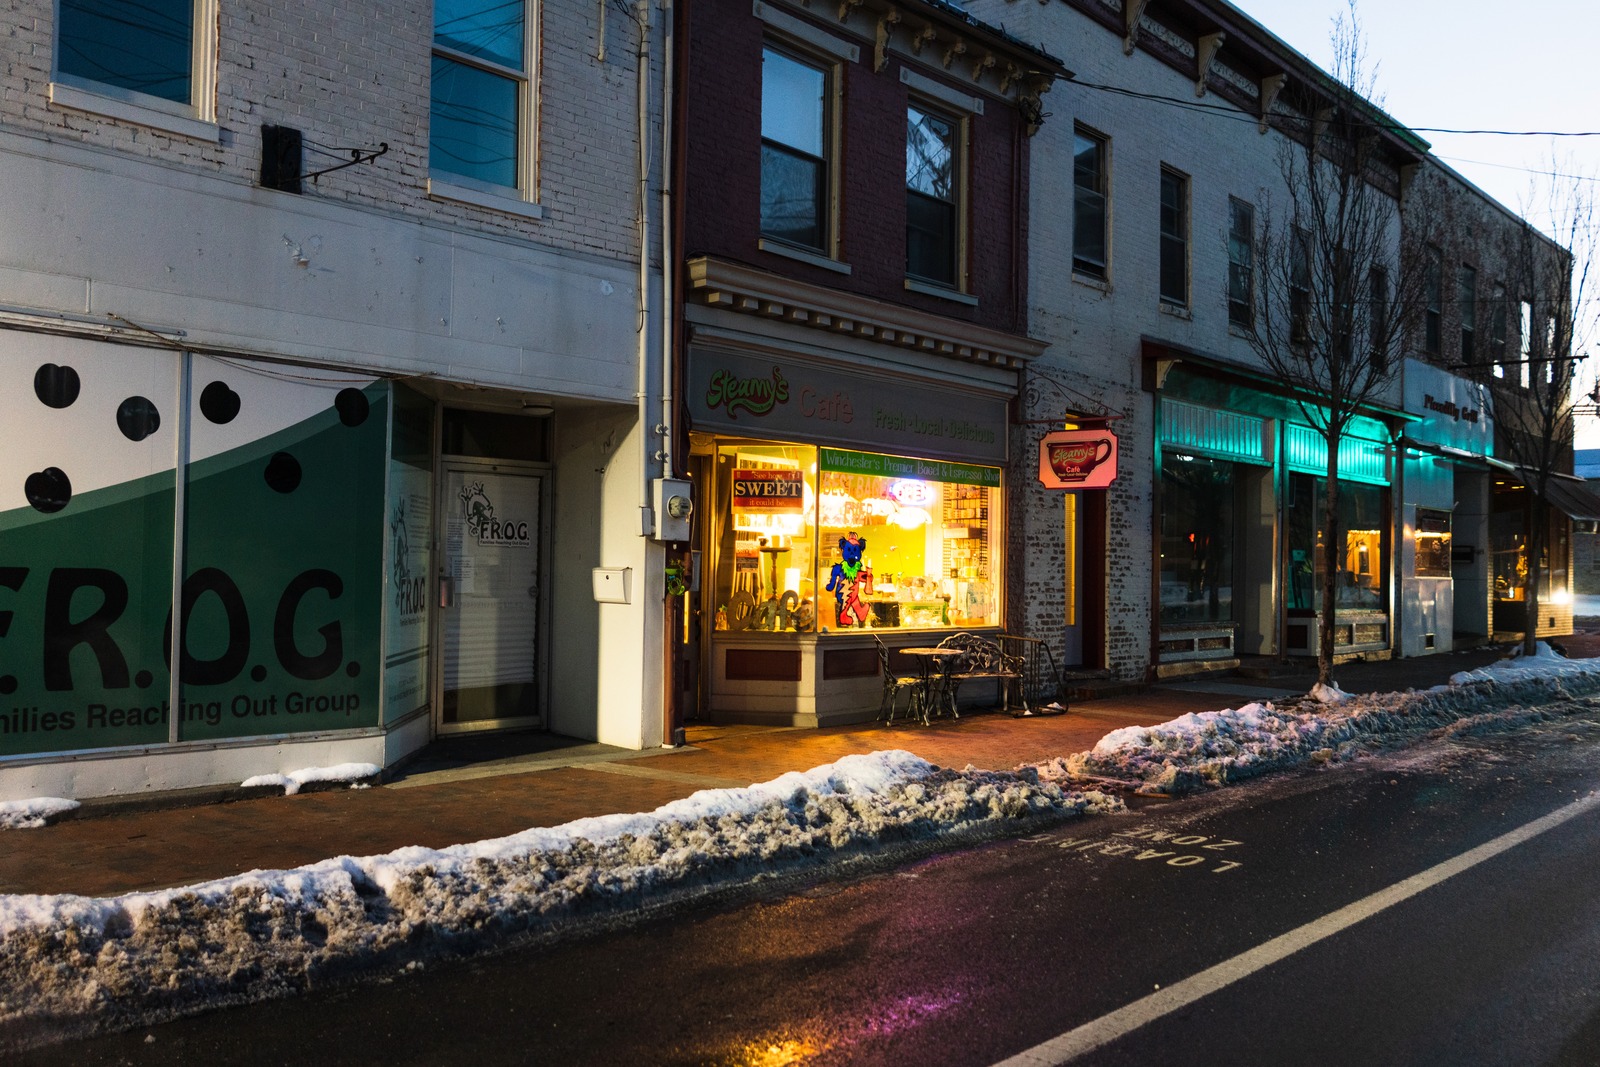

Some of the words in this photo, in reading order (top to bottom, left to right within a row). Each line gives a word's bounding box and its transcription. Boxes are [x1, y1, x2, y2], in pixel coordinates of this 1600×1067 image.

[706, 365, 790, 420] Steamy's
[800, 386, 853, 422] Café
[874, 407, 906, 431] Fresh
[911, 411, 944, 437] Local
[948, 419, 995, 444] Delicious
[825, 450, 881, 471] Winchester's
[883, 457, 914, 473] Premier
[917, 461, 940, 476] Bagel
[941, 464, 948, 478] &
[950, 464, 983, 482] Espresso
[984, 469, 1000, 483] Shop
[735, 481, 801, 497] SWEET
[823, 472, 854, 497] BEST
[480, 521, 530, 540] F.R.O.G.
[231, 694, 277, 719] Out
[285, 692, 360, 716] Group
